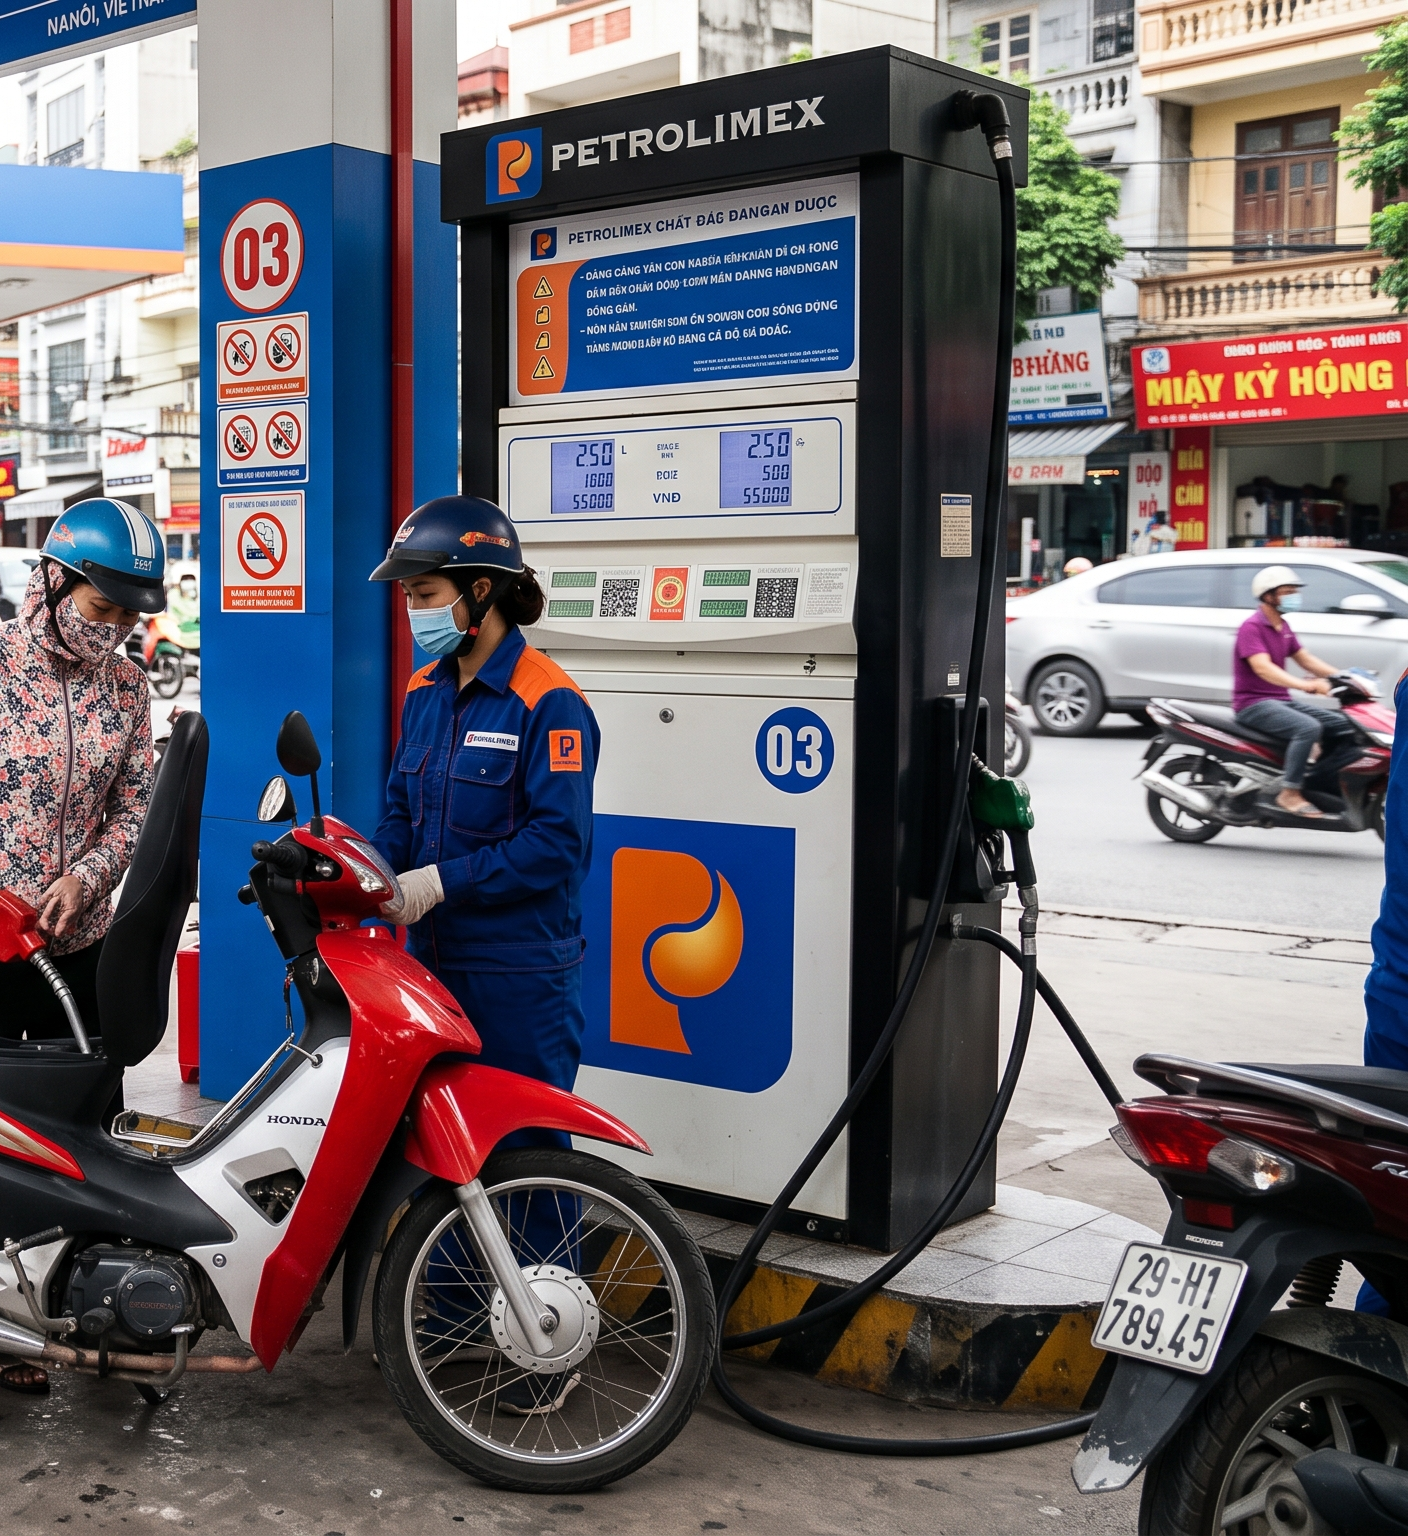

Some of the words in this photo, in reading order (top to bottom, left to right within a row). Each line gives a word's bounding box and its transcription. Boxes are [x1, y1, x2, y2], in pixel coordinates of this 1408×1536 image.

[552, 96, 825, 171] PETROLIMEX
[568, 222, 652, 245] PETROLIMEX
[233, 221, 290, 292] 03
[664, 260, 685, 272] CON
[772, 302, 803, 316] SÓNG
[1289, 358, 1394, 399] HỘNG
[576, 442, 613, 467] 2.50
[621, 445, 627, 455] L
[747, 431, 790, 459] 2.50
[762, 464, 790, 481] 500
[573, 493, 613, 510] 55000
[743, 487, 790, 504] 55000
[766, 724, 823, 778] 03
[267, 1115, 327, 1127] HONDA
[1127, 1253, 1222, 1310] 29-H1
[1101, 1298, 1215, 1362] 789.45
